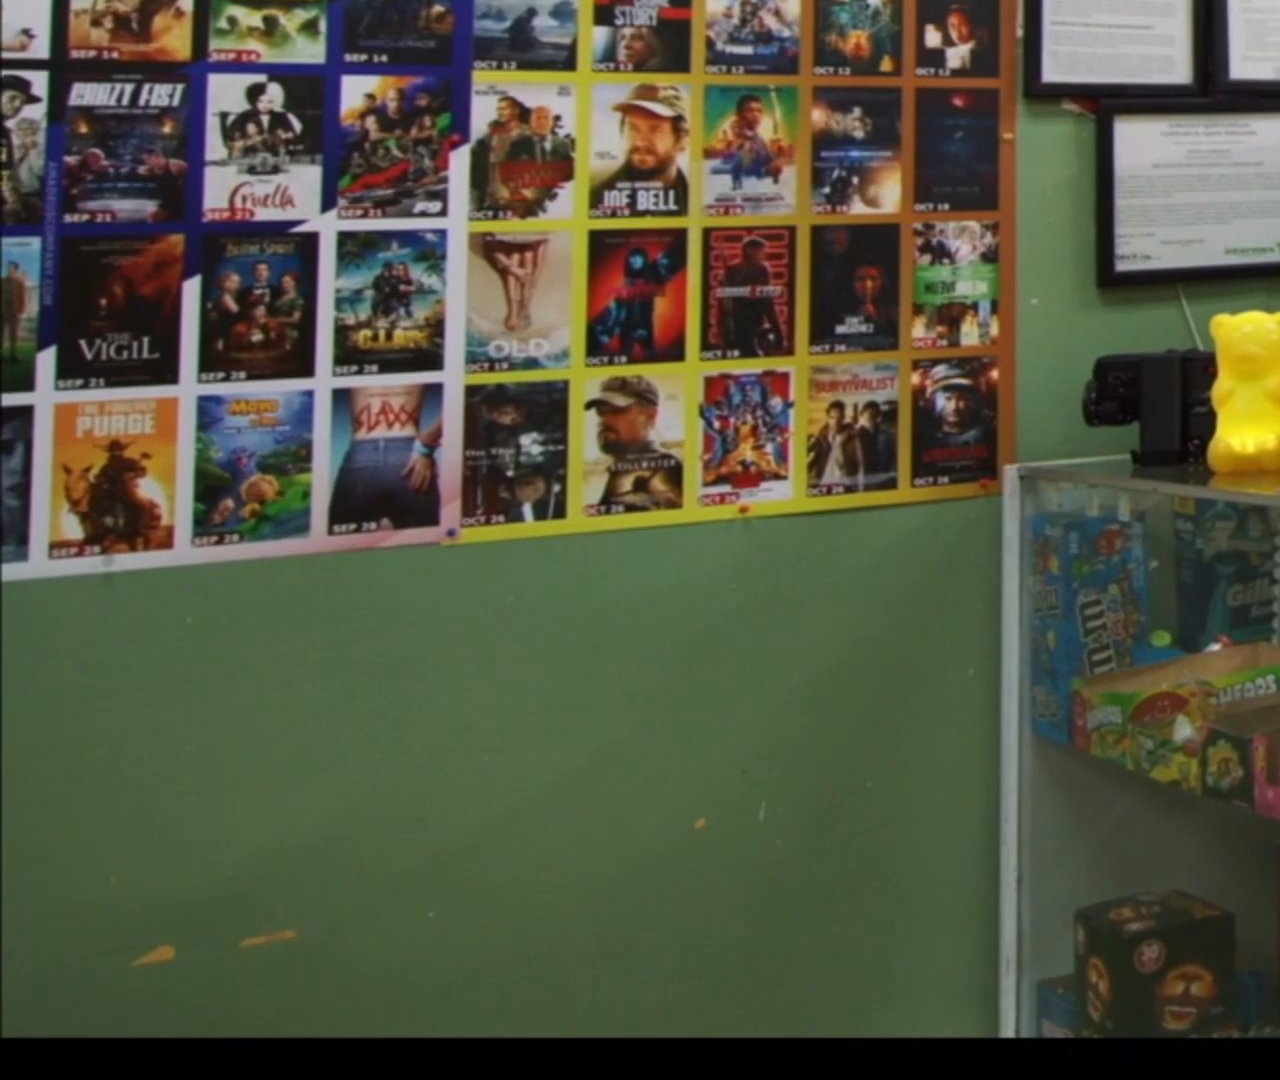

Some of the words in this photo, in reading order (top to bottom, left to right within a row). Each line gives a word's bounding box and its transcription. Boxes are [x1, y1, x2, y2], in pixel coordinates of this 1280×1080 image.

[613, 6, 660, 27] STORY
[209, 50, 239, 62] SEP
[242, 51, 260, 62] 14
[474, 60, 496, 71] OCT
[500, 60, 517, 71] 12
[68, 81, 134, 107] CRAZY
[141, 80, 187, 107] FIST
[228, 179, 297, 211] Cruella
[637, 188, 678, 212] BELL
[63, 212, 93, 223] SEP
[97, 212, 113, 223] 21
[413, 200, 444, 214] F9
[78, 334, 160, 362] VIGIL
[488, 338, 550, 359] OLD
[813, 374, 897, 397] SURVIVALIST
[75, 413, 157, 439] PURGE
[352, 402, 420, 433] SLAXX
[610, 457, 678, 473] STILLWATER
[332, 523, 358, 534] SEP
[361, 521, 379, 533] 28
